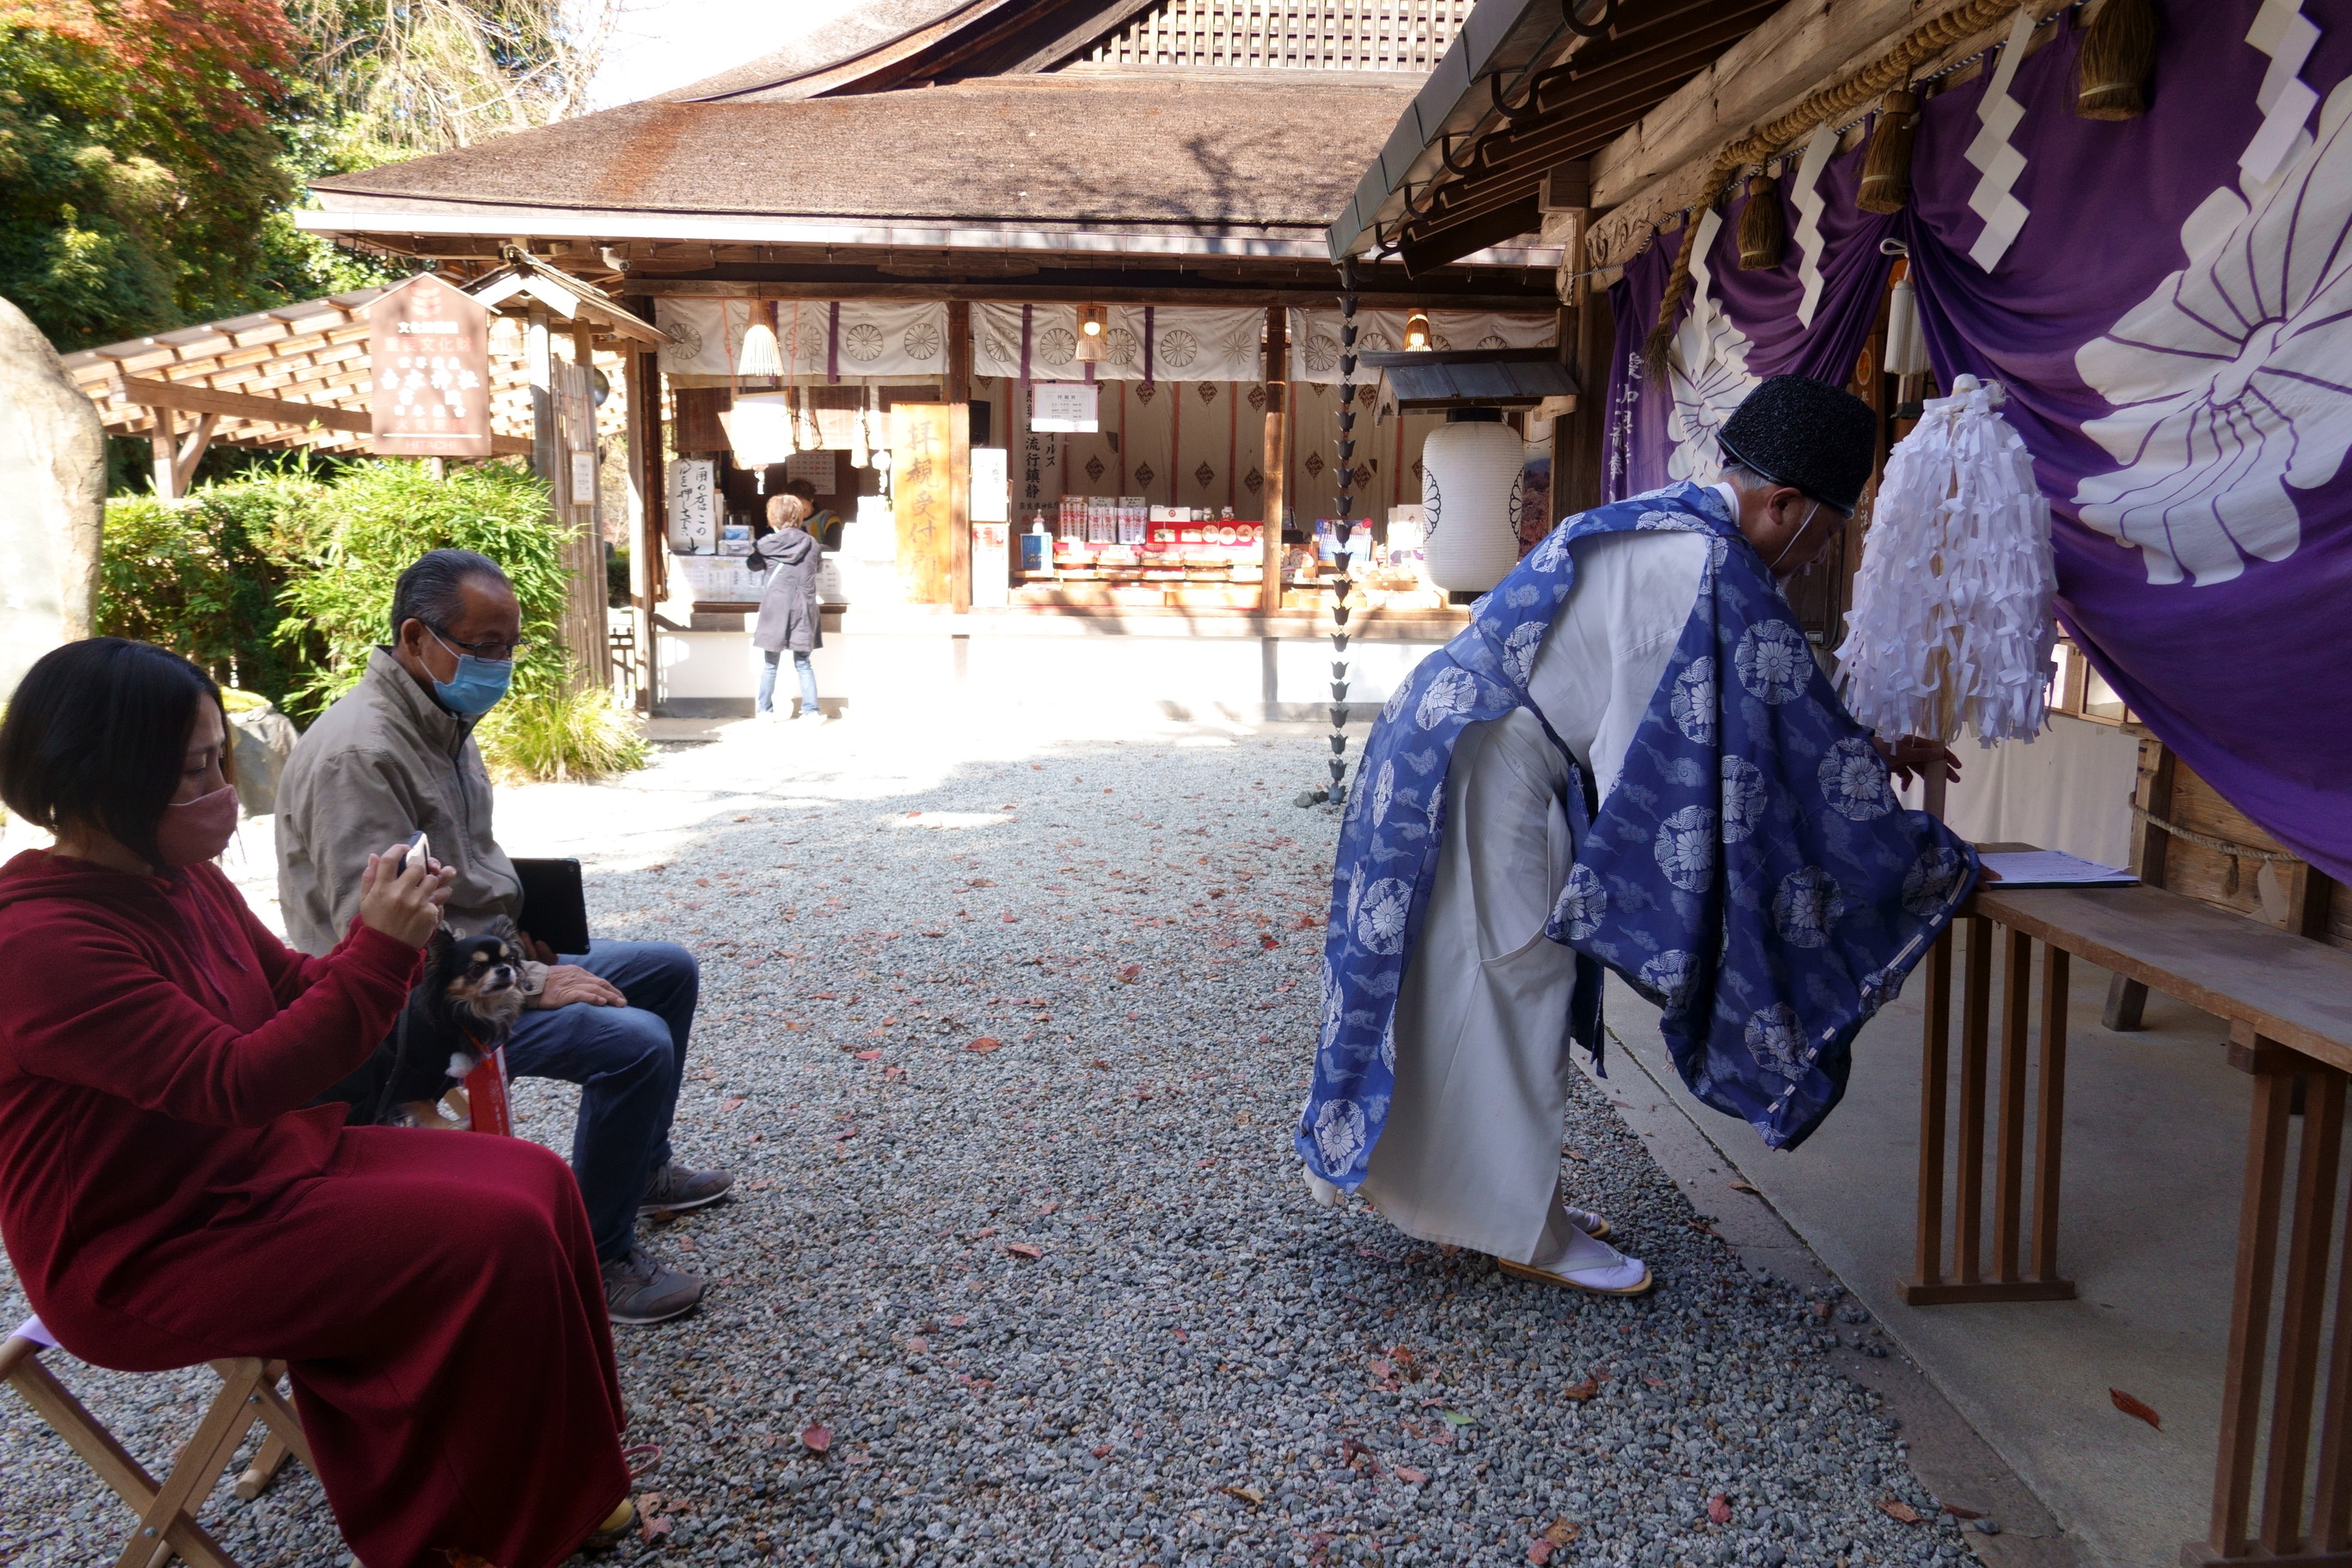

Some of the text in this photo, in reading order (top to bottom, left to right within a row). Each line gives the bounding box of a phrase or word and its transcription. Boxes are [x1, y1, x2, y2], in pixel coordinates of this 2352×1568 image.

[384, 336, 472, 352] 重要文化財
[405, 440, 456, 450] HITACHI
